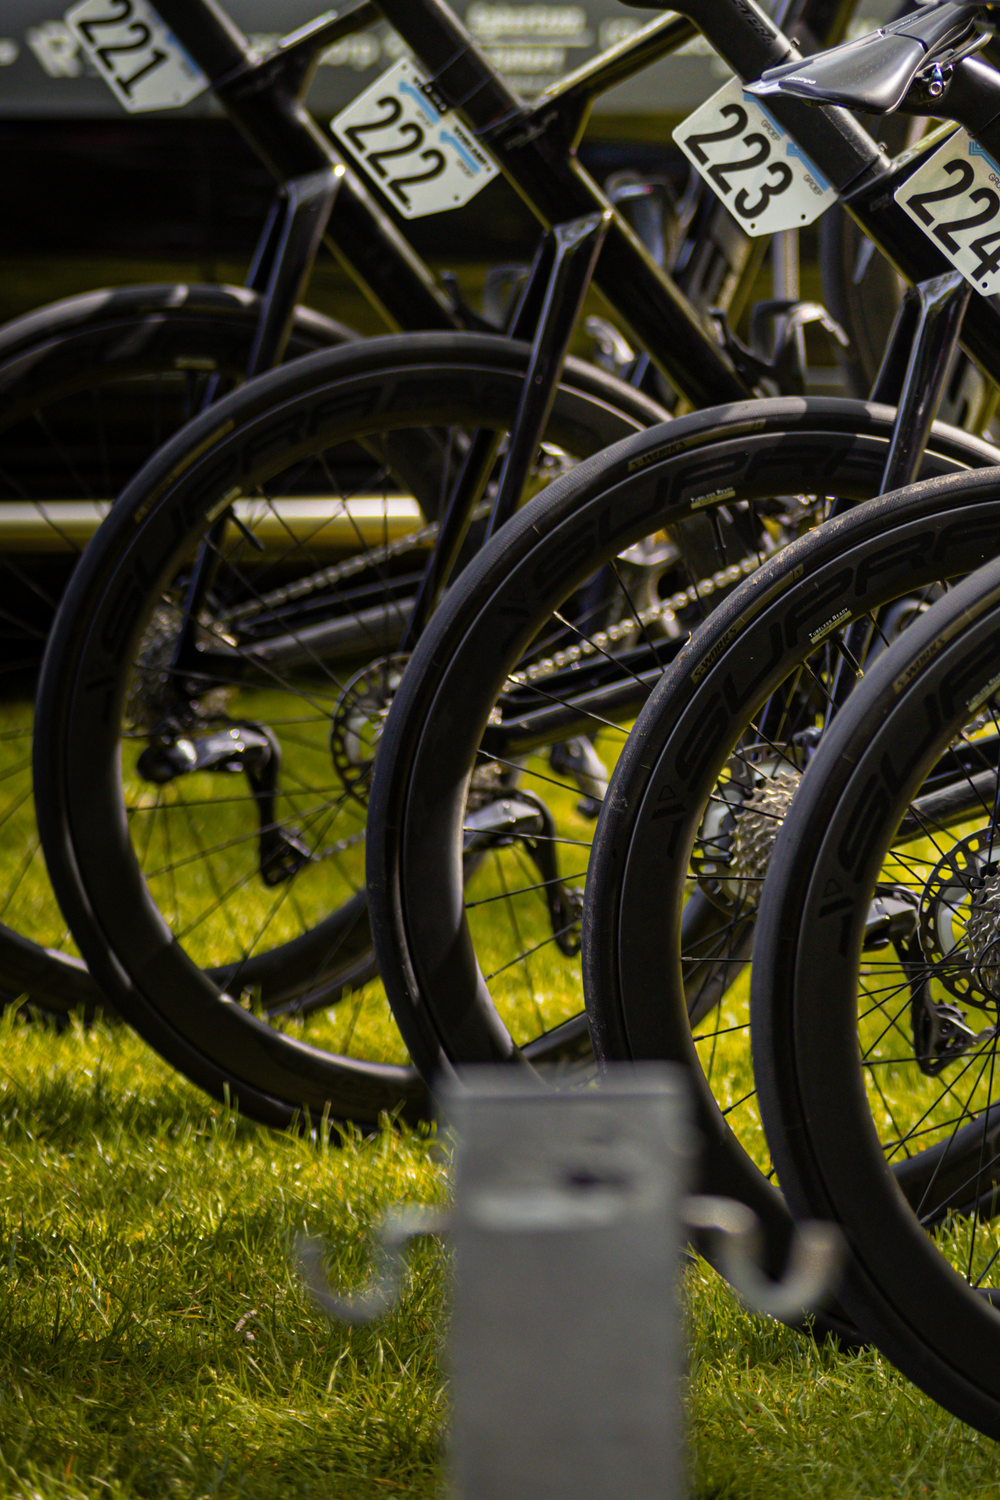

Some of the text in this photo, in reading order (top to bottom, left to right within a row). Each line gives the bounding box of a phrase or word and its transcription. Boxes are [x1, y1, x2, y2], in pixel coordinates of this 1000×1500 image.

[760, 118, 781, 142] GROEP
[343, 95, 447, 205] 222
[683, 103, 794, 220] 223
[803, 173, 824, 196] GROEP
[831, 607, 848, 621] READY
[693, 627, 737, 678] S-WORKS
